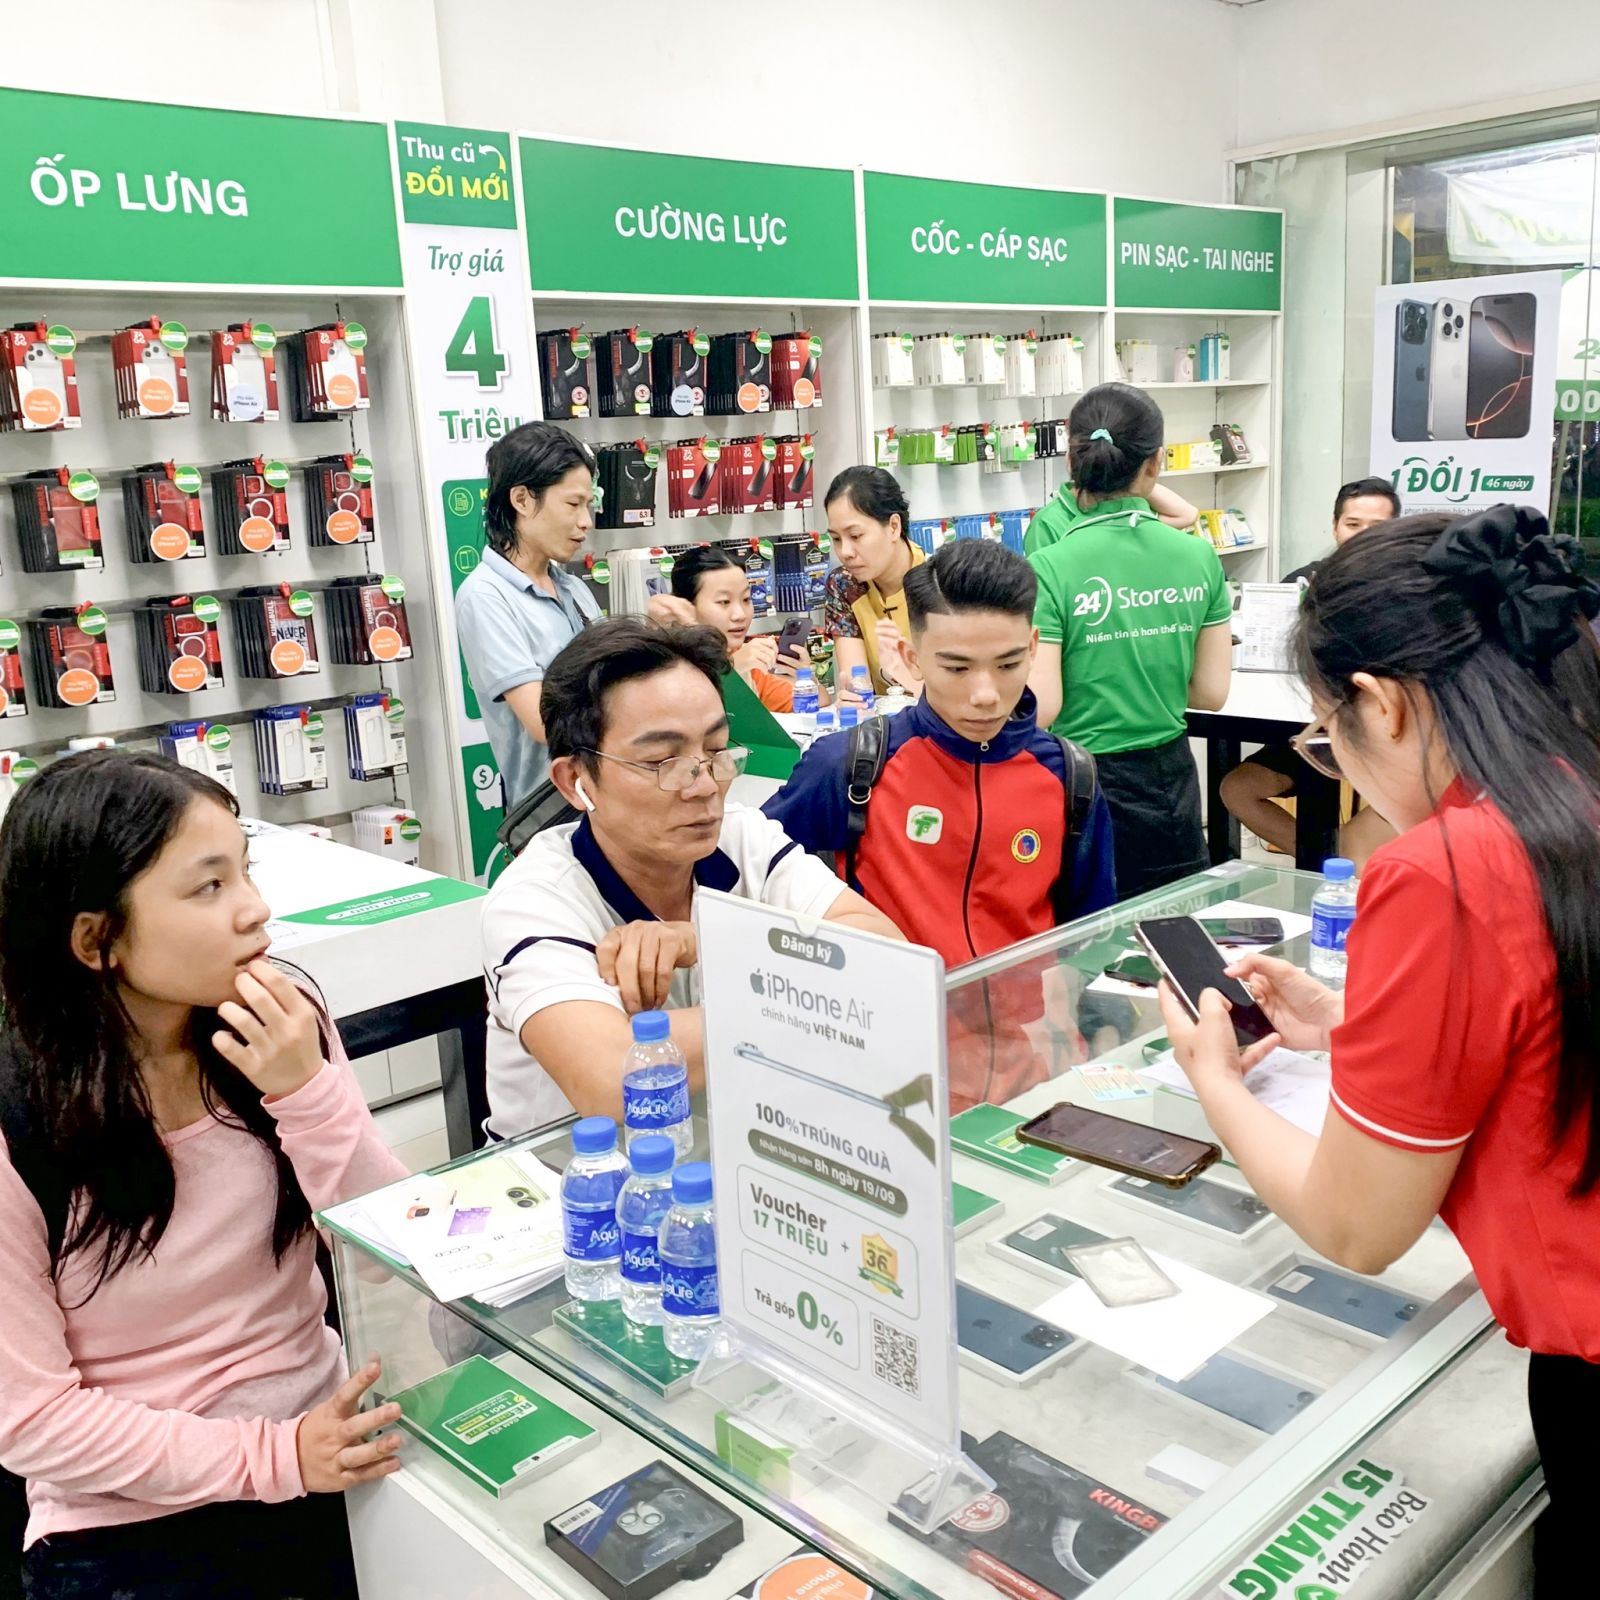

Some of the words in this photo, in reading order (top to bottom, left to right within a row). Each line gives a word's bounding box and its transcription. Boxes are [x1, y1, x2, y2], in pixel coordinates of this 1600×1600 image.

[401, 136, 445, 161] Thu
[450, 141, 475, 163] cũ
[30, 153, 101, 208] ỐP
[116, 169, 249, 218] LƯNG
[405, 164, 454, 197] ĐỔI
[461, 171, 509, 201] MỚI
[614, 201, 725, 243] CƯỜNG
[734, 211, 787, 252] LỰC
[910, 219, 961, 255] CỐC
[979, 227, 1022, 260] CÁP
[1026, 235, 1068, 268] SẠC
[427, 245, 463, 276] Trợ
[468, 247, 505, 277] giá
[1120, 241, 1150, 267] PIN
[1154, 243, 1189, 273] SẠC
[1202, 246, 1227, 271] TAI
[1230, 248, 1274, 273] NGHE
[445, 296, 506, 387] 4
[1407, 456, 1463, 493] ĐỔI
[1470, 468, 1481, 493] 1
[1486, 478, 1501, 489] 46
[1502, 477, 1529, 491] ngày
[1115, 629, 1129, 639] tin
[781, 934, 814, 959] Đăng
[816, 942, 833, 964] ký
[766, 972, 842, 1020] iPhone
[846, 997, 874, 1030] Air
[761, 1006, 786, 1024] chính
[787, 1013, 811, 1035] hãng
[812, 1022, 837, 1041] VIỆT
[839, 1031, 866, 1050] NAM
[627, 1101, 668, 1117] AquaLife
[857, 1145, 892, 1174] QUÀ
[814, 1158, 829, 1176] 8h
[831, 1169, 860, 1191] ngày
[861, 1179, 896, 1205] 19/09
[750, 1183, 827, 1233] Voucher
[753, 1209, 769, 1229] 17
[774, 1217, 829, 1257] TRIỆU
[865, 1249, 888, 1273] 36
[754, 1287, 772, 1307] Trả
[774, 1300, 796, 1320] góp
[796, 1290, 844, 1346] 0%
[1342, 1458, 1394, 1499] 15
[1088, 1488, 1165, 1532] KINGB
[1375, 1490, 1428, 1530] Bảo
[1228, 1491, 1366, 1600] THÁNG
[1317, 1526, 1389, 1585] Hành
